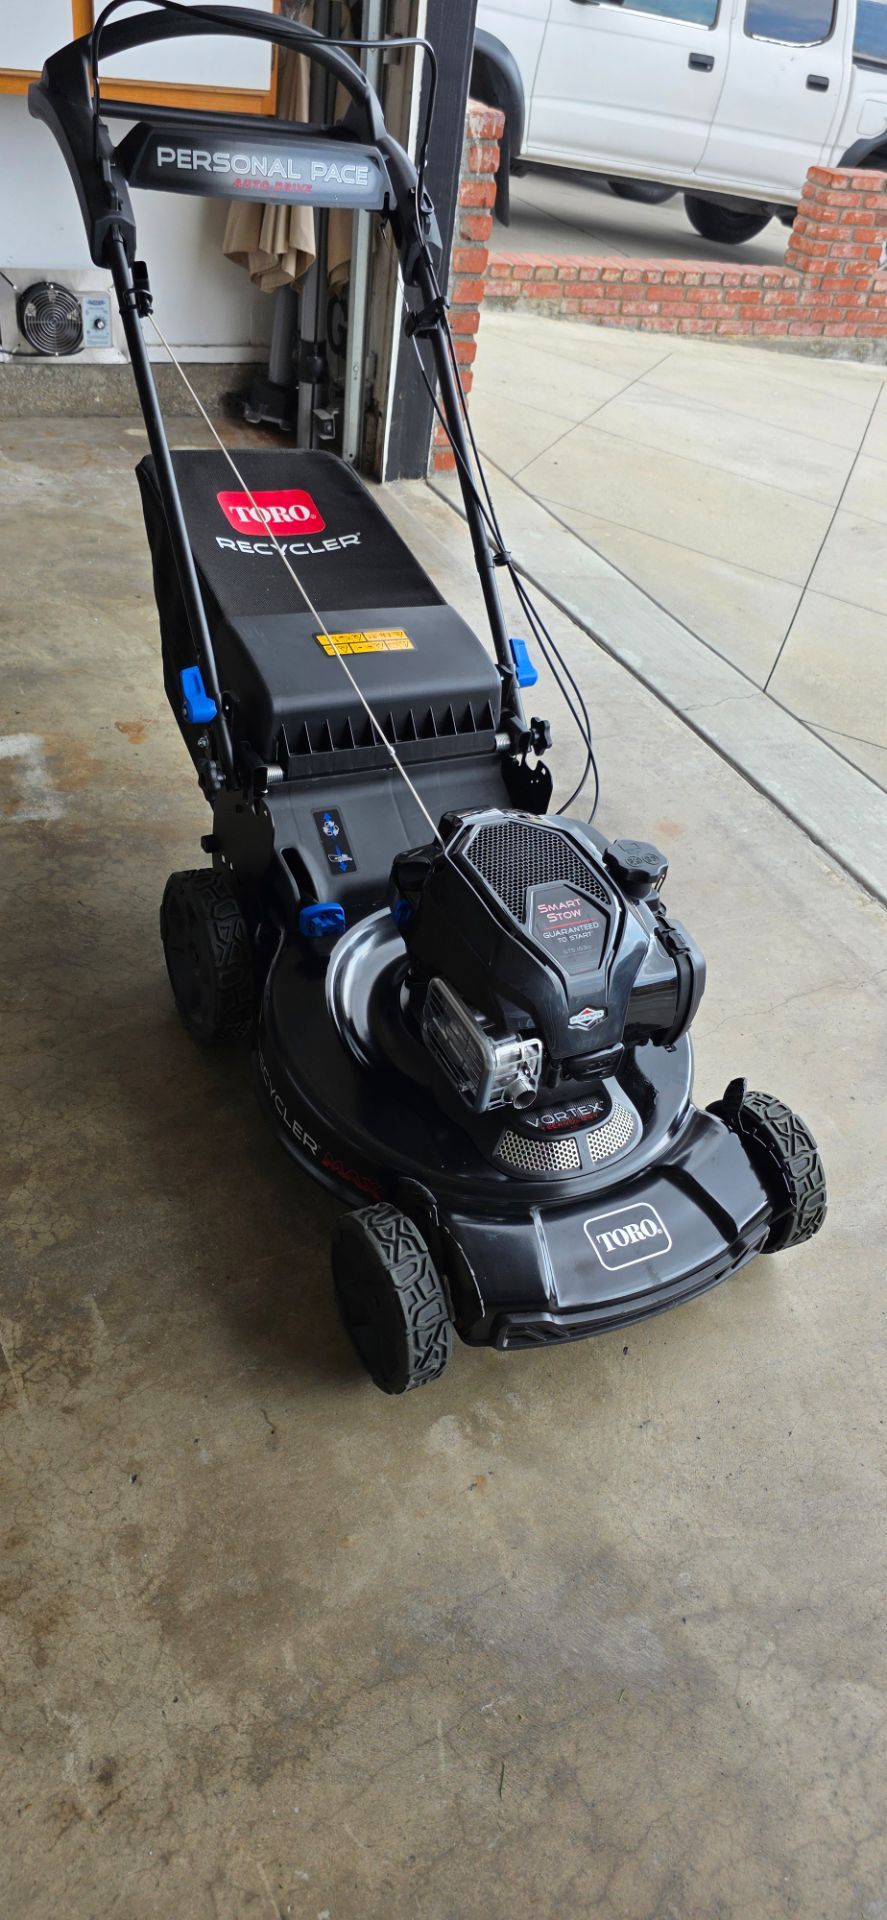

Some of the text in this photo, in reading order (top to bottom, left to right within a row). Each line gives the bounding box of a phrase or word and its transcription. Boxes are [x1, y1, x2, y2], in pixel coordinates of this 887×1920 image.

[157, 147, 368, 186] PERSONAL PACE
[229, 505, 311, 524] TORO
[216, 534, 361, 556] RECYCLER
[537, 899, 581, 914] SMART
[546, 909, 582, 923] STOW
[543, 921, 599, 939] GUARANTEED
[569, 931, 593, 941] START
[526, 1101, 604, 1128] VORTEX
[596, 1218, 659, 1253] TORO
